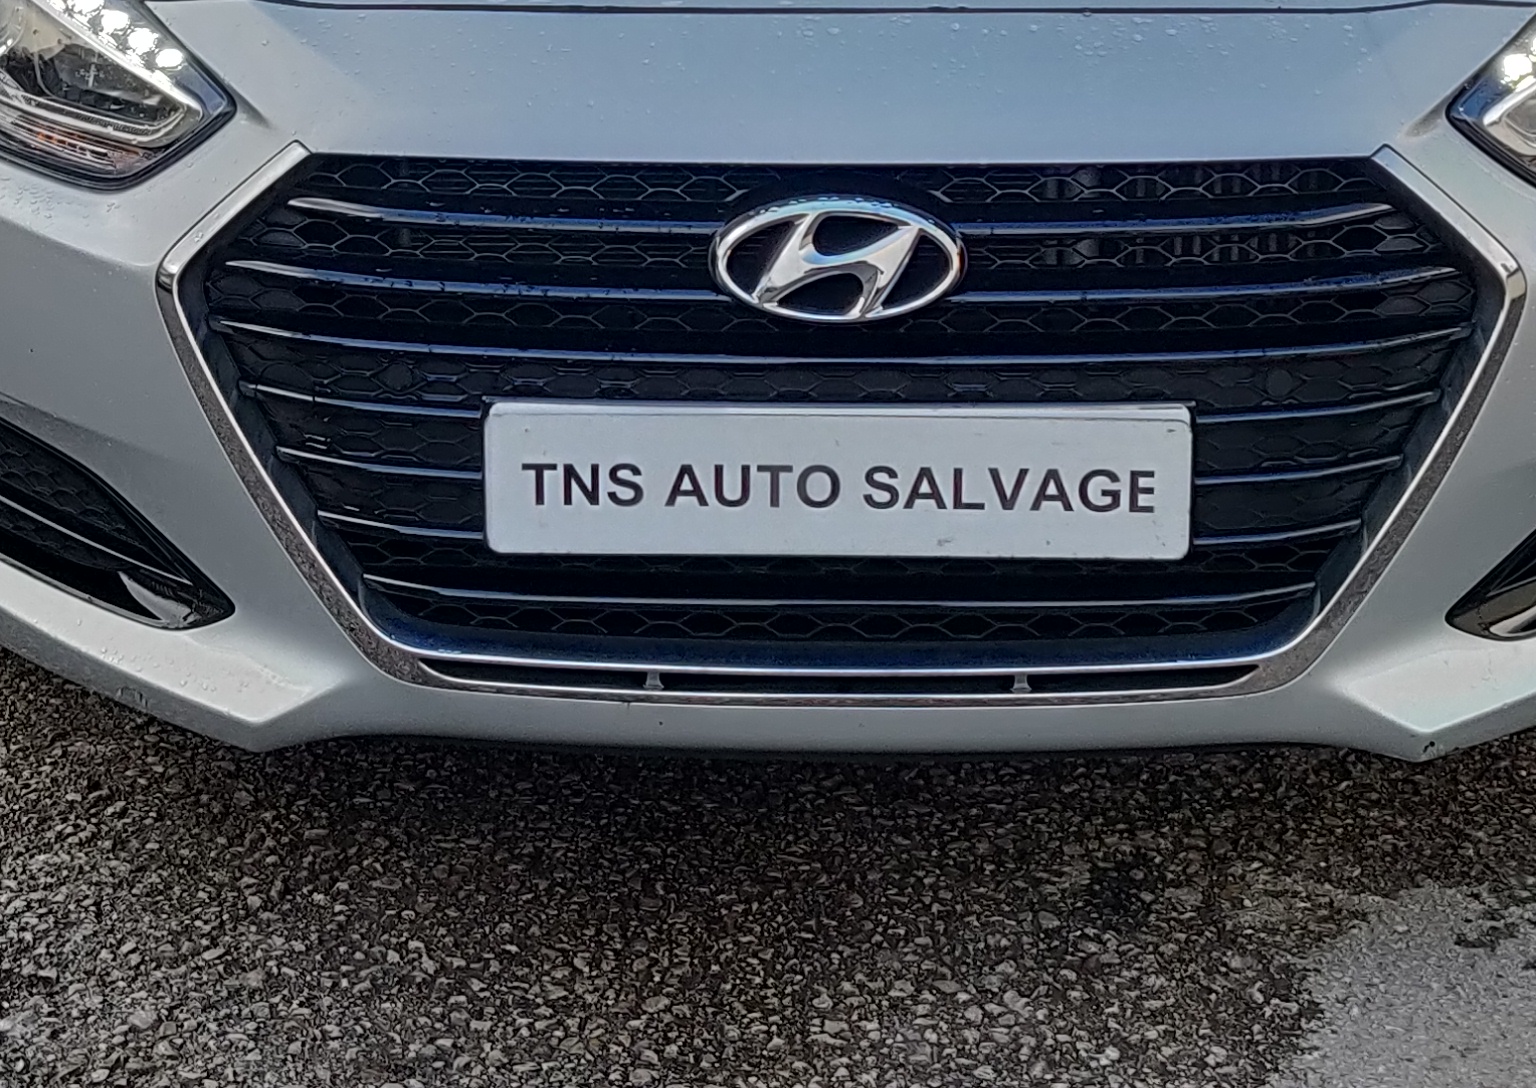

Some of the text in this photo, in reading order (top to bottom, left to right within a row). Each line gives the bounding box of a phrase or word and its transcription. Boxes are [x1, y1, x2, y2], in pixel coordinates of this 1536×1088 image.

[520, 463, 1157, 514] TNS AUTO SALVAGE
